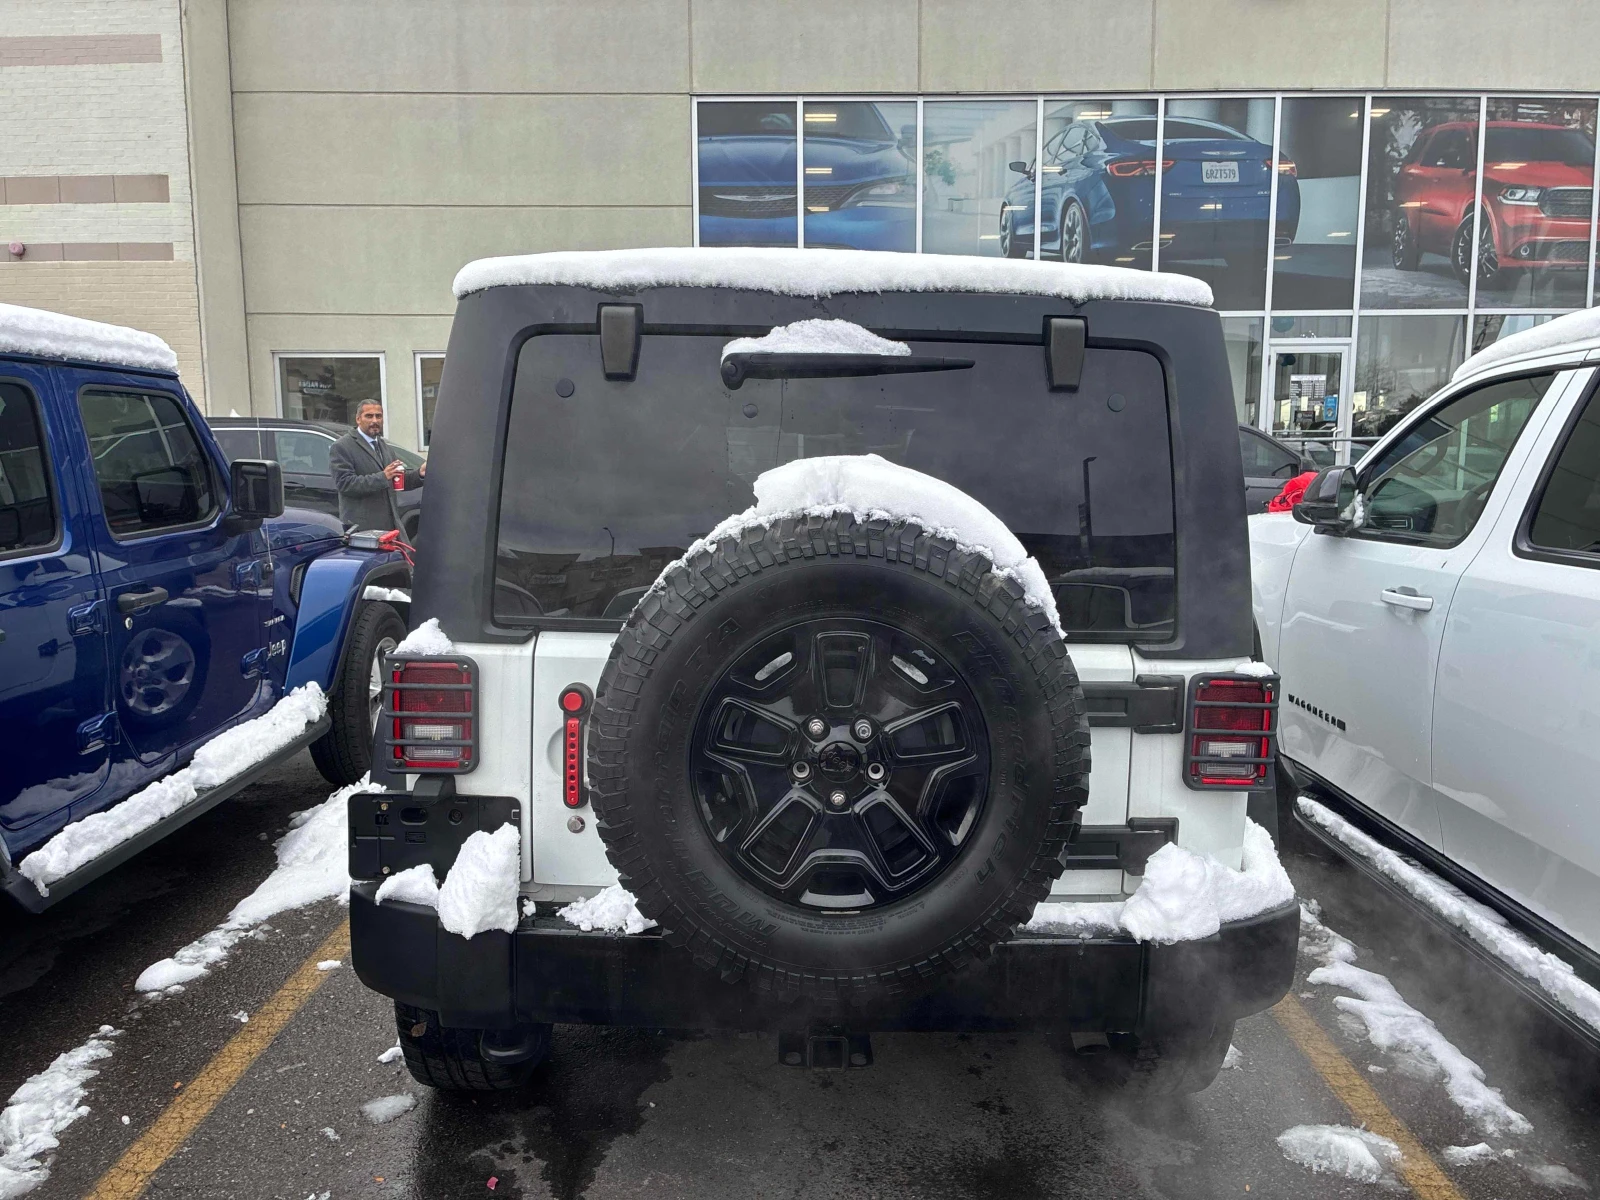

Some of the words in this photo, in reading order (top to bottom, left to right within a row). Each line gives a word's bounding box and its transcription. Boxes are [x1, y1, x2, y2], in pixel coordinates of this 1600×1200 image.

[1205, 168, 1236, 179] 6RZT579
[266, 639, 286, 661] Jeep
[1288, 693, 1336, 726] WAGONEER
